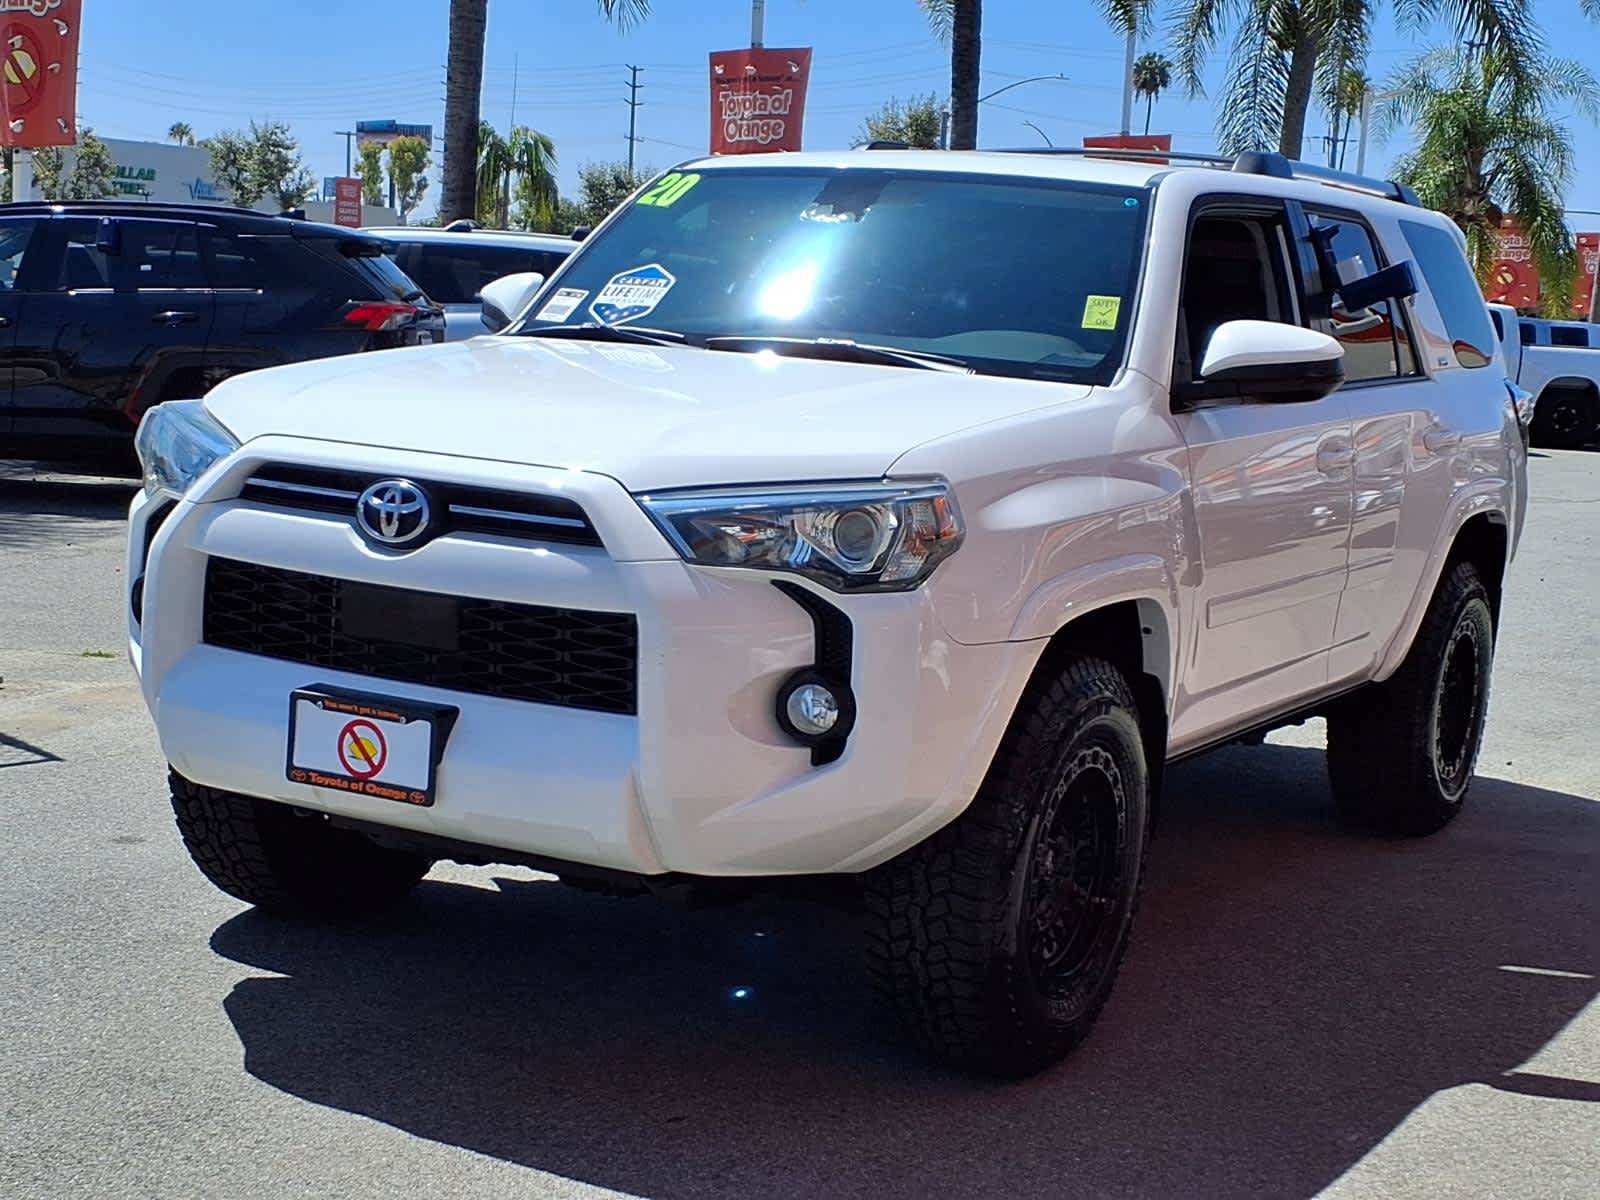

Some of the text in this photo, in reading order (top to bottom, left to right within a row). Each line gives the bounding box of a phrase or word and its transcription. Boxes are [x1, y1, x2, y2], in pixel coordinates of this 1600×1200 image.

[720, 89, 792, 119] Toyota of
[724, 118, 785, 144] Orange
[636, 173, 701, 207] 20
[603, 286, 665, 299] LIFETIME
[1096, 319, 1108, 327] OK
[309, 772, 408, 800] Toyota of Orange
